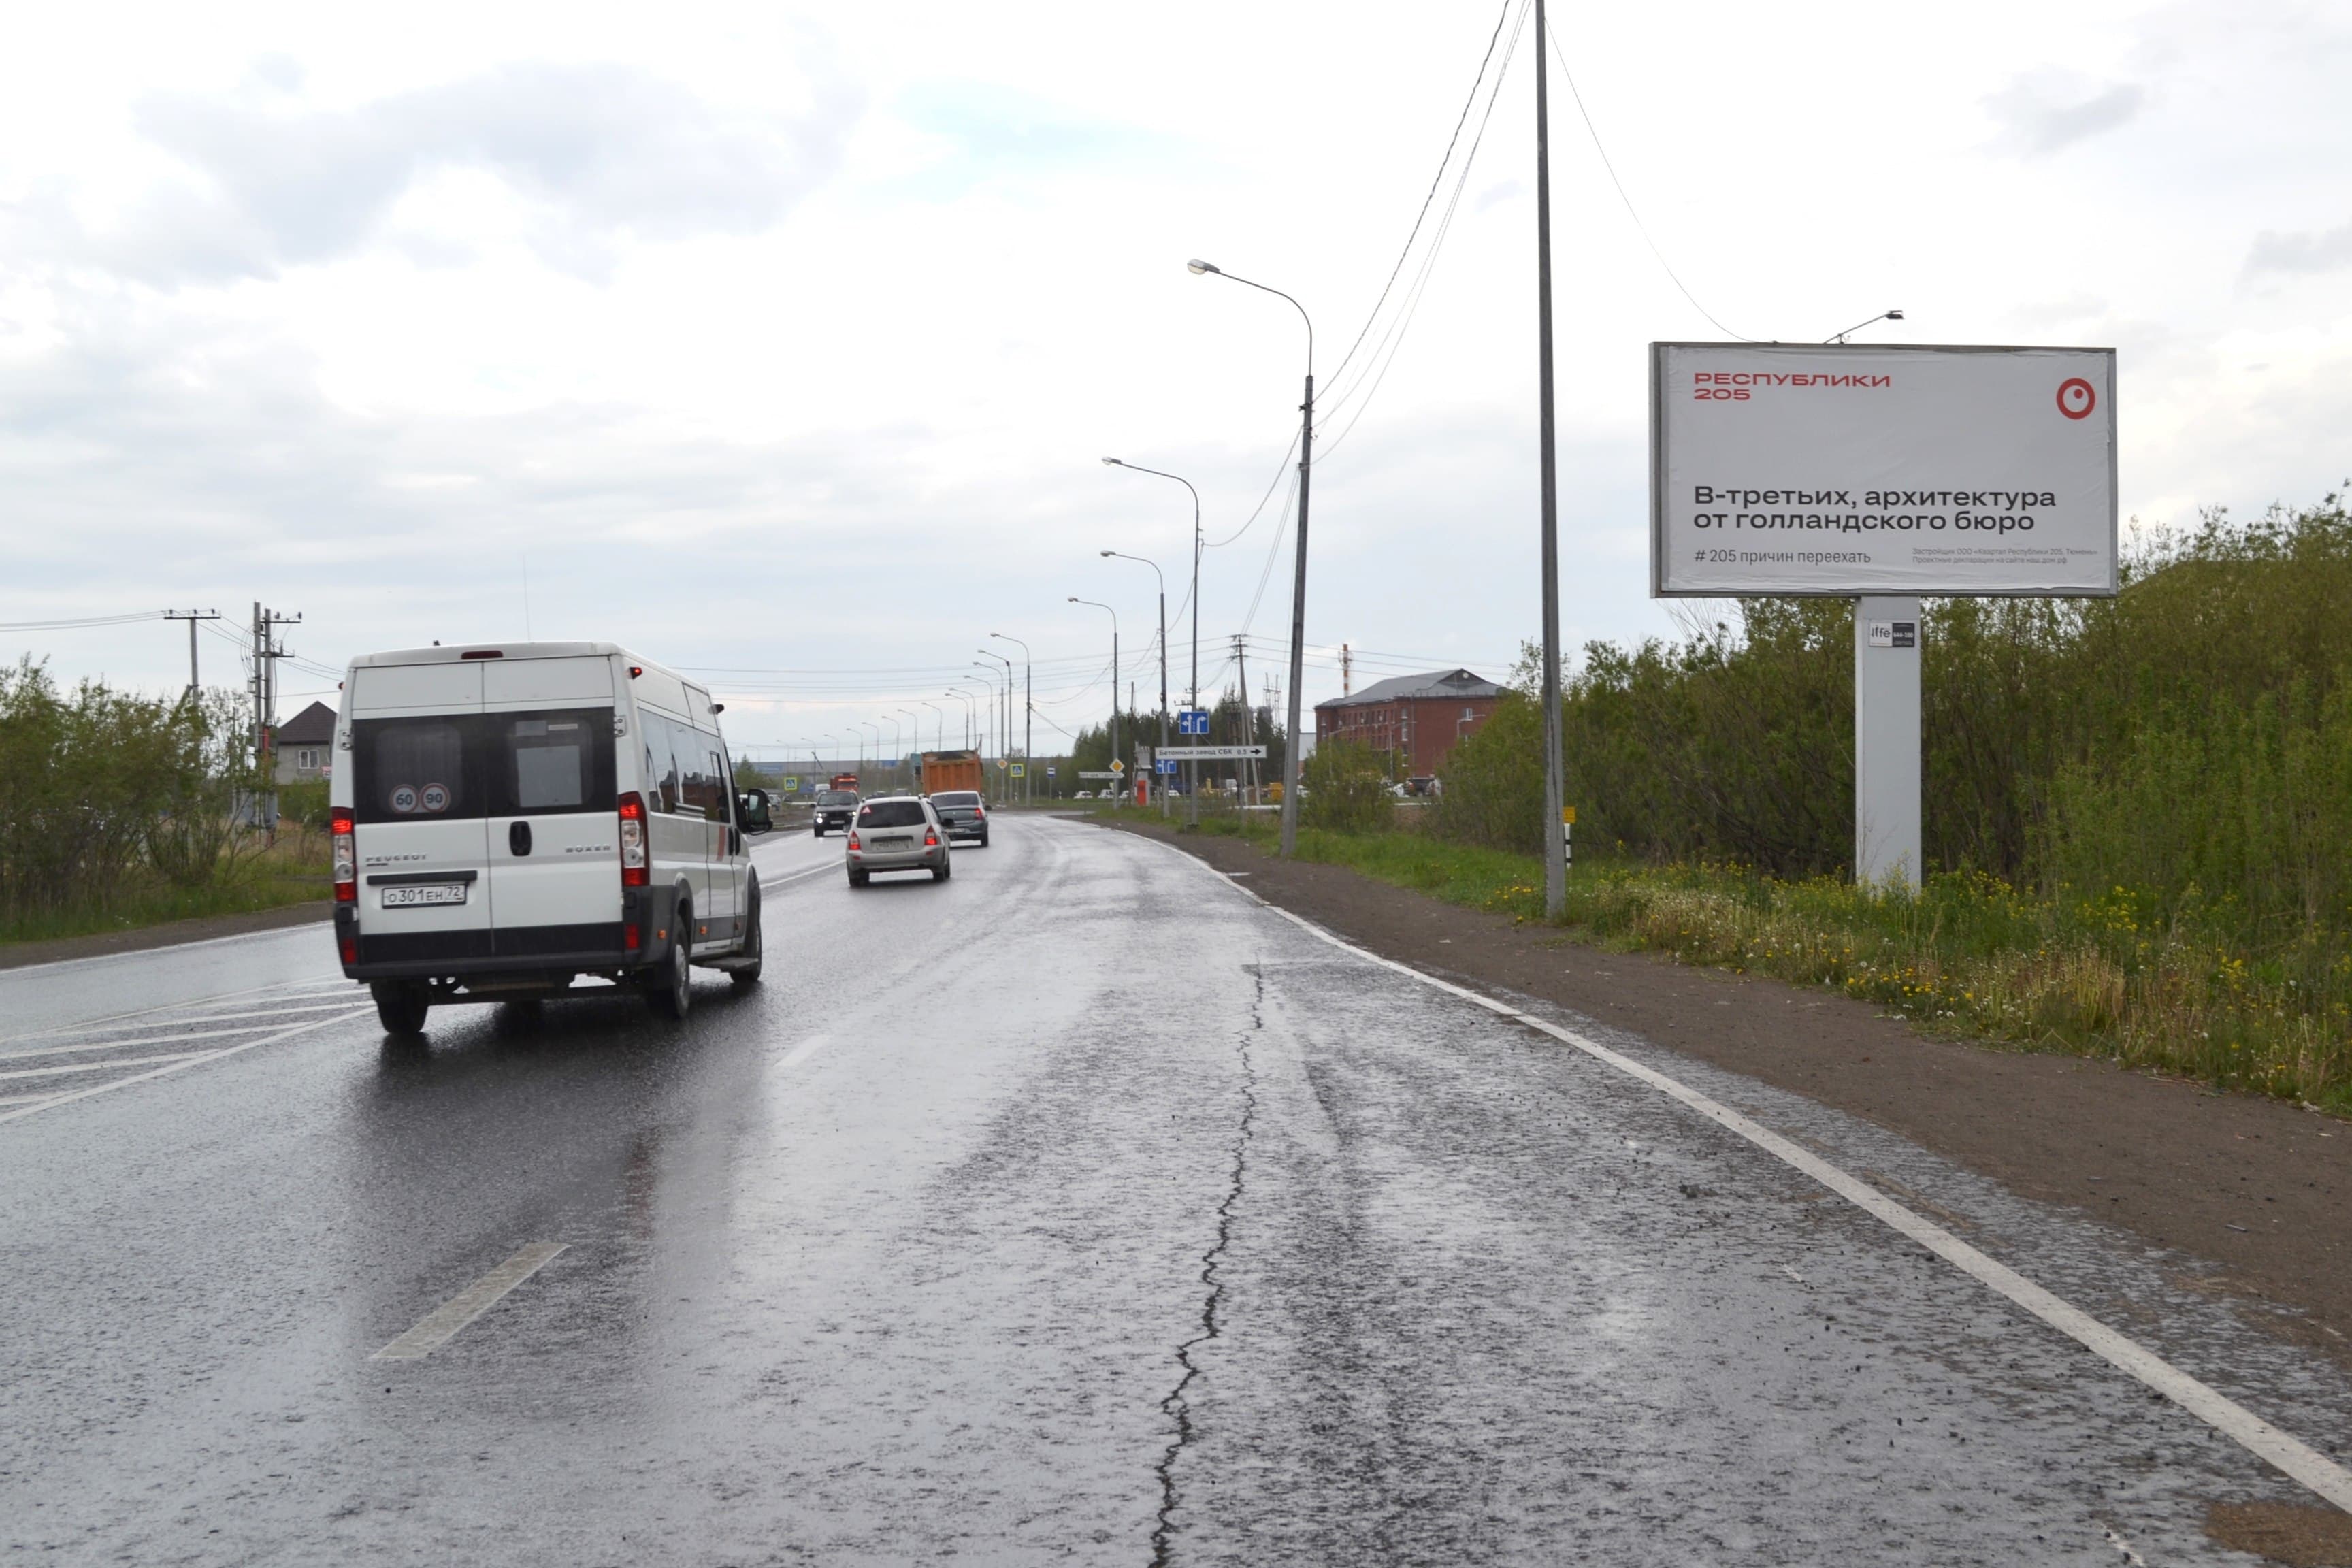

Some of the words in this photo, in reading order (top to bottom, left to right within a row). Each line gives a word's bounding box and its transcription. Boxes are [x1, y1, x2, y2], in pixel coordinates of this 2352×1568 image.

[1694, 372, 1890, 387] РЕСПУБЛИКИ
[1694, 388, 1750, 400] 205
[1694, 485, 1857, 509] В-третьих,
[1865, 490, 2057, 511] архитектура
[1693, 513, 1729, 528] от
[1735, 514, 1946, 533] голландского
[1955, 510, 2035, 535] бюро
[1695, 550, 1706, 562] #
[1710, 549, 1736, 563] 205
[1740, 551, 1794, 565] причин
[1797, 551, 1872, 566] переехать
[396, 794, 413, 805] 60
[426, 794, 442, 804] 90
